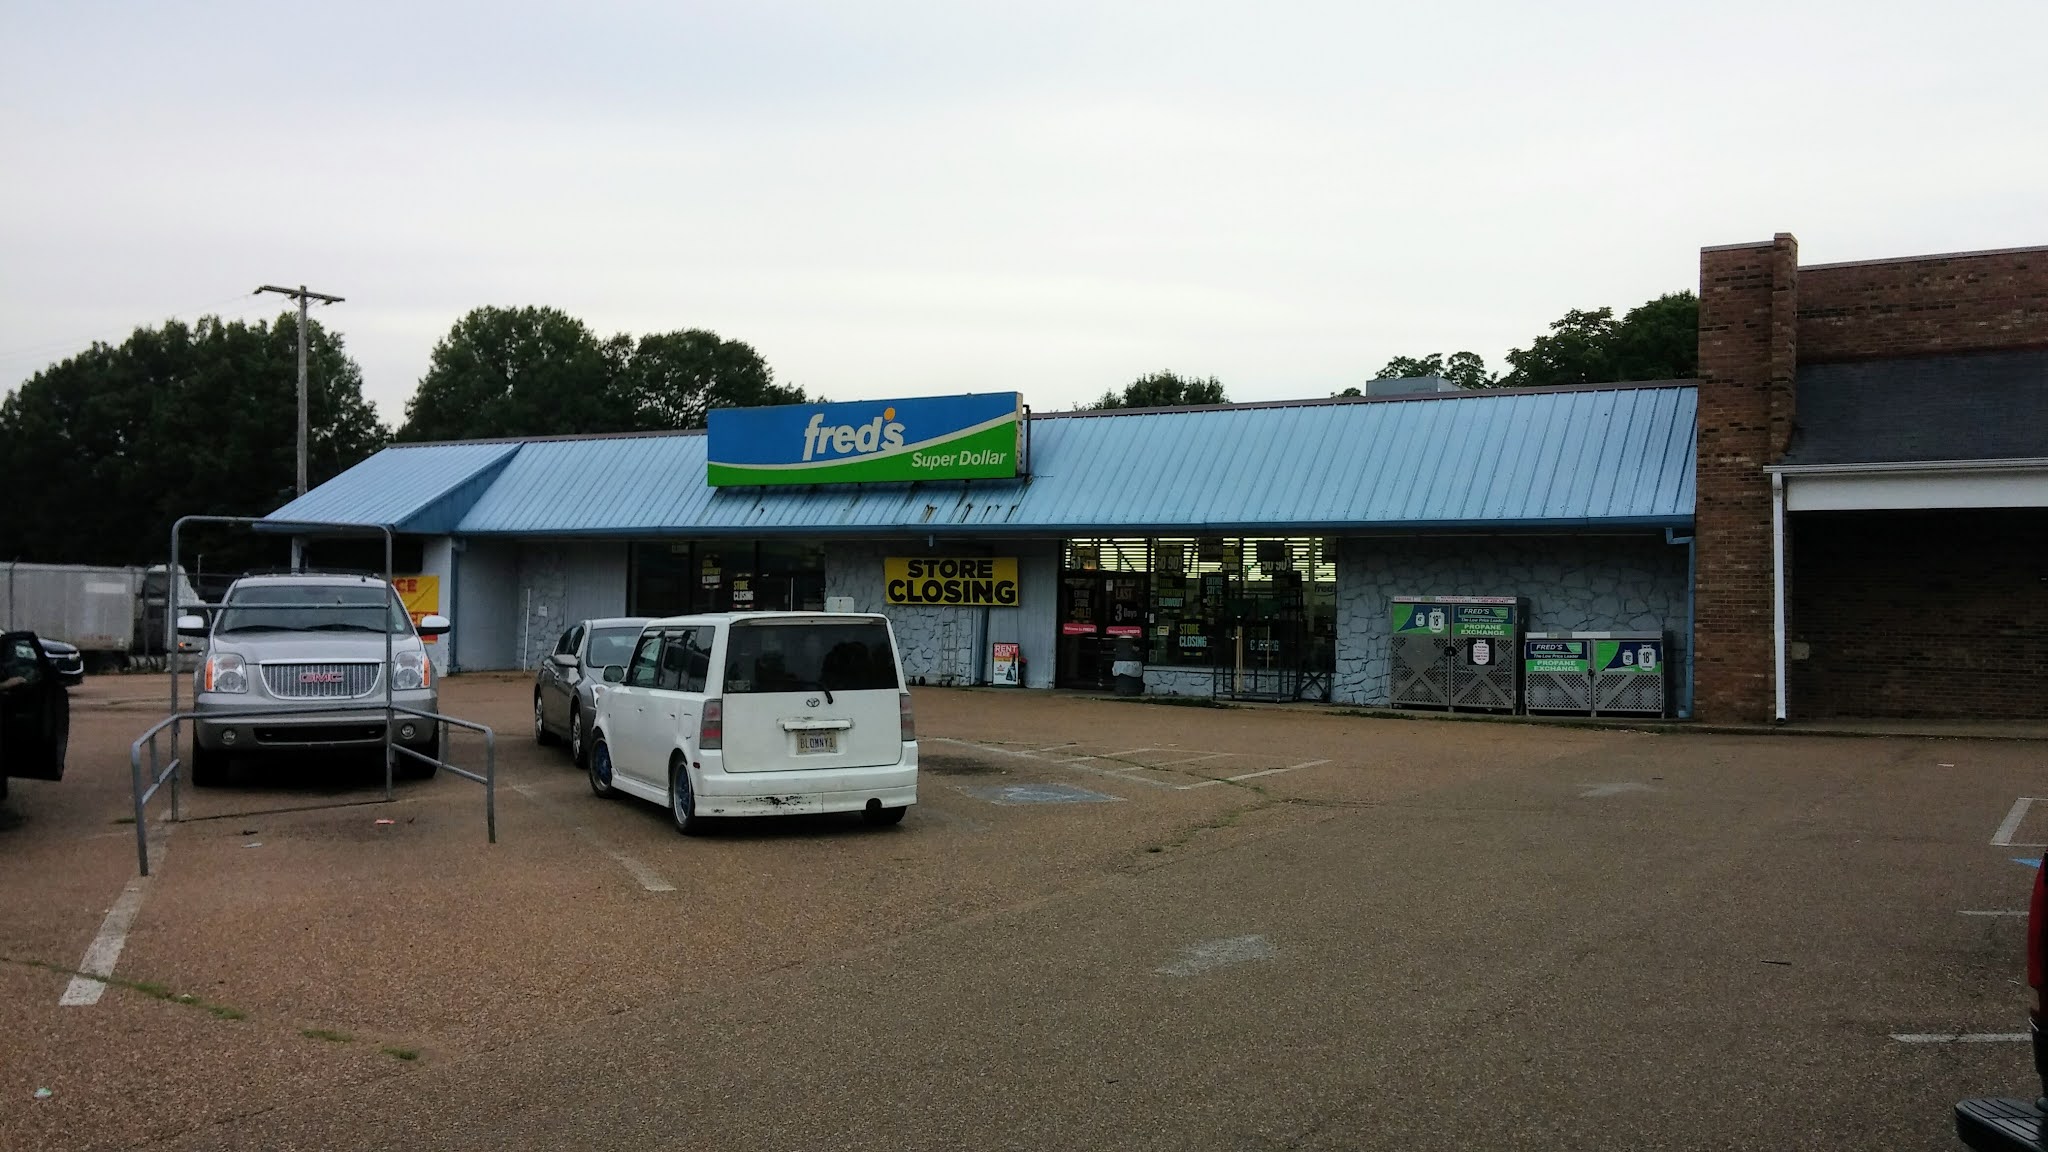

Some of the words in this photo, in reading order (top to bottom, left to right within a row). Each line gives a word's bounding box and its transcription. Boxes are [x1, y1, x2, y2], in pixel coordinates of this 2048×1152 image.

[802, 407, 906, 461] fred's
[911, 451, 957, 471] Super
[958, 449, 1007, 467] Dollar
[907, 559, 993, 579] STORE
[888, 579, 1016, 604] CLOSING
[1179, 623, 1200, 635] STORE
[994, 644, 1018, 653] RENT
[1178, 635, 1208, 648] CLOSING
[300, 672, 344, 683] GMC
